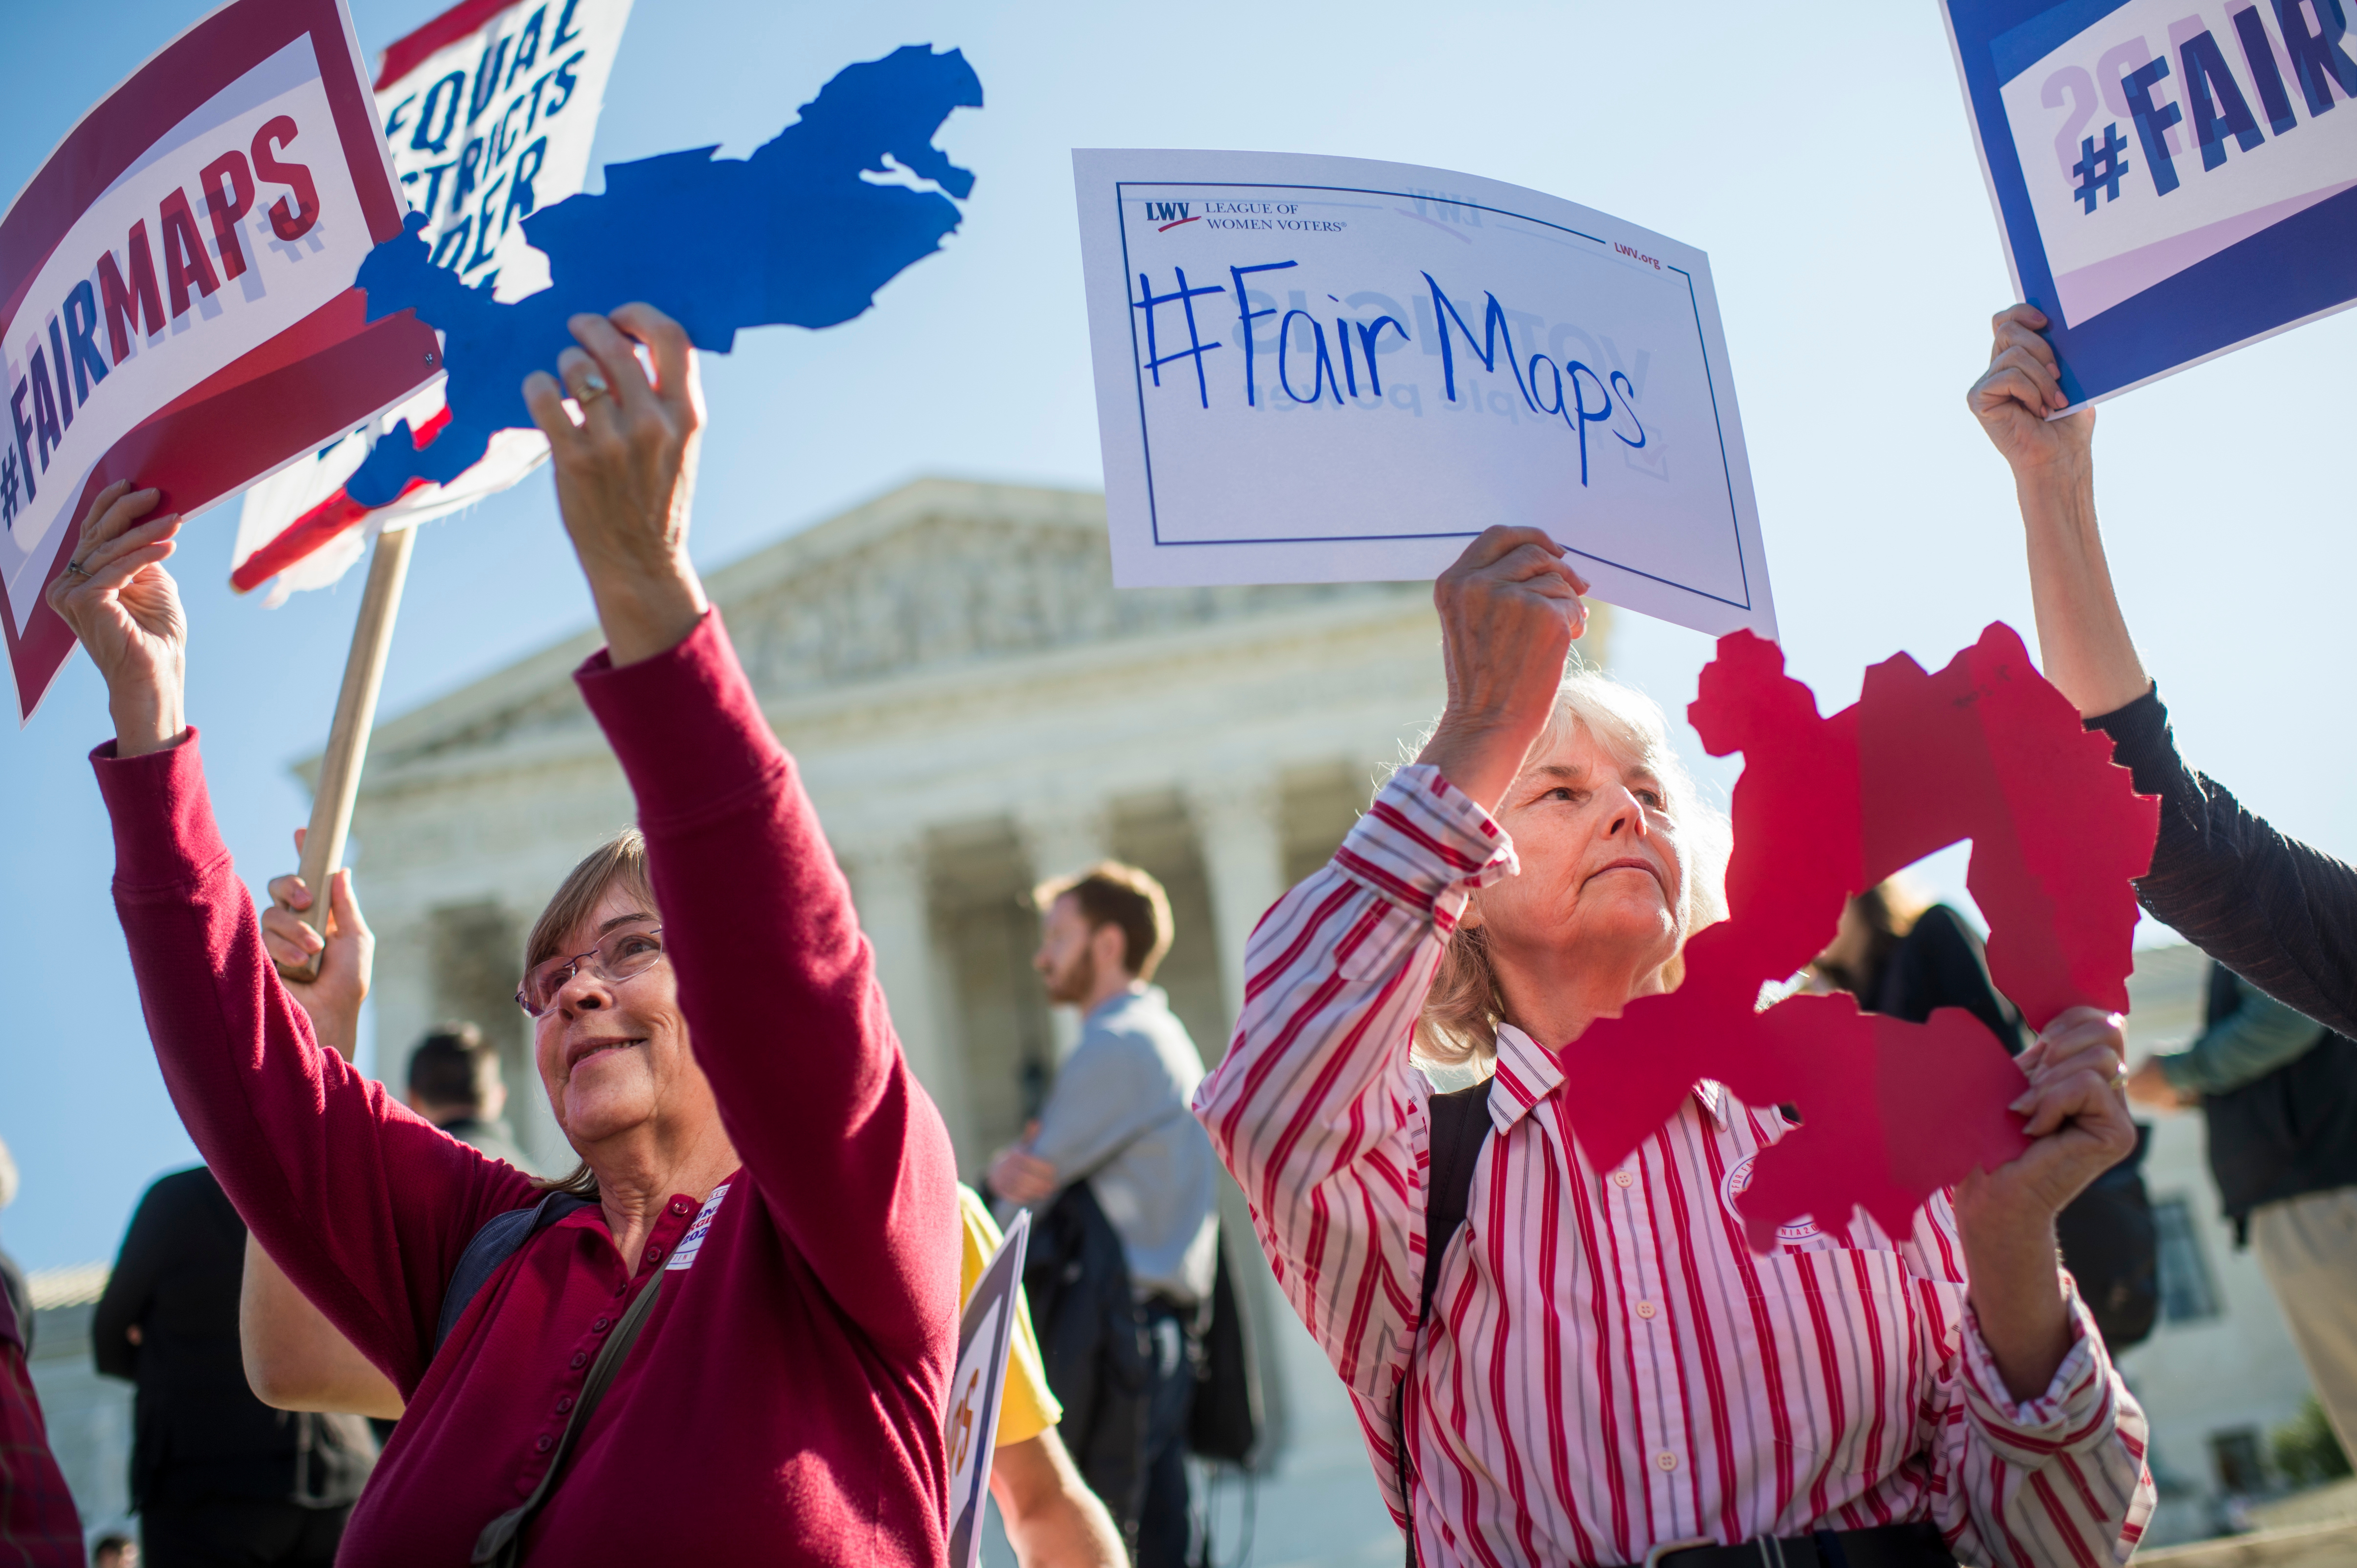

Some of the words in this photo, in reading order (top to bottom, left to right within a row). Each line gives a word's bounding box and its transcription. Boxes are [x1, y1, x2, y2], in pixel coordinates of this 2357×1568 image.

[1145, 202, 1190, 221] LWV
[1205, 203, 1273, 214] LEAGUE
[1277, 204, 1299, 215] OF
[1206, 219, 1272, 230] WOMEN
[1614, 242, 1661, 270] LWV.org
[1, 115, 320, 533] #FAIRMAPS
